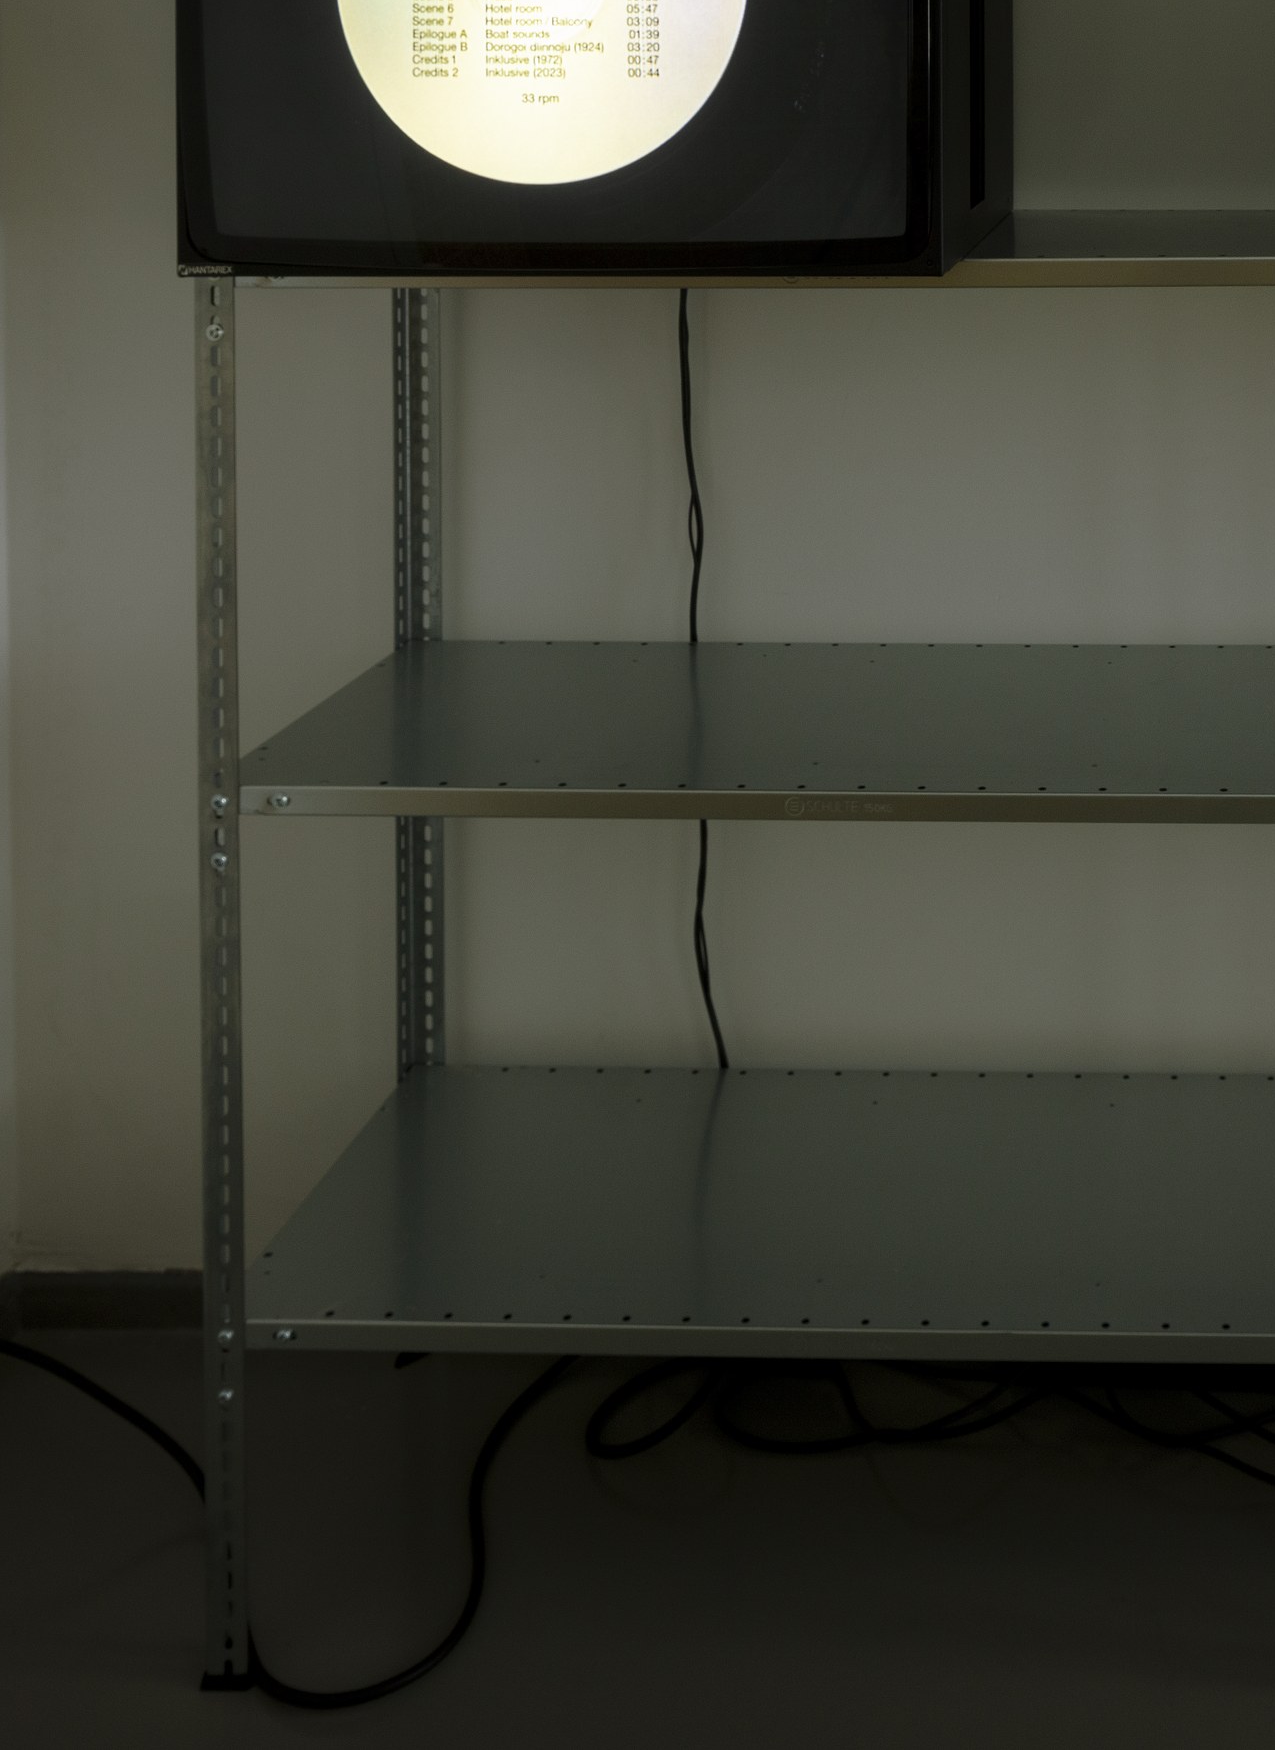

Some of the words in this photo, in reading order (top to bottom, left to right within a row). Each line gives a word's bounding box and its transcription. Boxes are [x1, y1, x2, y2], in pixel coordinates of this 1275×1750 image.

[412, 4, 445, 13] Scene
[447, 4, 454, 13] 6
[485, 4, 512, 13] Hotel
[515, 4, 543, 13] room
[626, 4, 659, 13] 05:47
[412, 16, 445, 26] Scene
[447, 16, 454, 26] 7
[485, 16, 512, 26] Hotel
[515, 16, 543, 26] room
[626, 16, 660, 26] 03:09
[412, 29, 457, 42] Epilogue
[459, 29, 468, 39] A
[485, 29, 510, 39] Boat
[512, 29, 551, 39] sounds
[628, 29, 660, 39] 01:39
[412, 42, 457, 55] Epilogue
[459, 42, 468, 52] B
[485, 42, 527, 55] Dorogoi
[529, 42, 572, 55] dlinnoju
[573, 42, 605, 54] (1924)
[627, 42, 662, 52] 03:20
[412, 55, 450, 64] Credits
[451, 55, 457, 64] 1
[485, 55, 530, 64] Inklusive
[532, 55, 563, 66] (1972)
[627, 55, 660, 64] 00:47
[412, 68, 450, 77] Credits
[451, 68, 459, 77] 2
[485, 68, 530, 77] Inklusive
[532, 68, 567, 79] (2023)
[627, 68, 661, 77] 00:44
[522, 94, 535, 103] 33
[538, 95, 560, 106] rpm
[188, 266, 232, 274] HANTAREX
